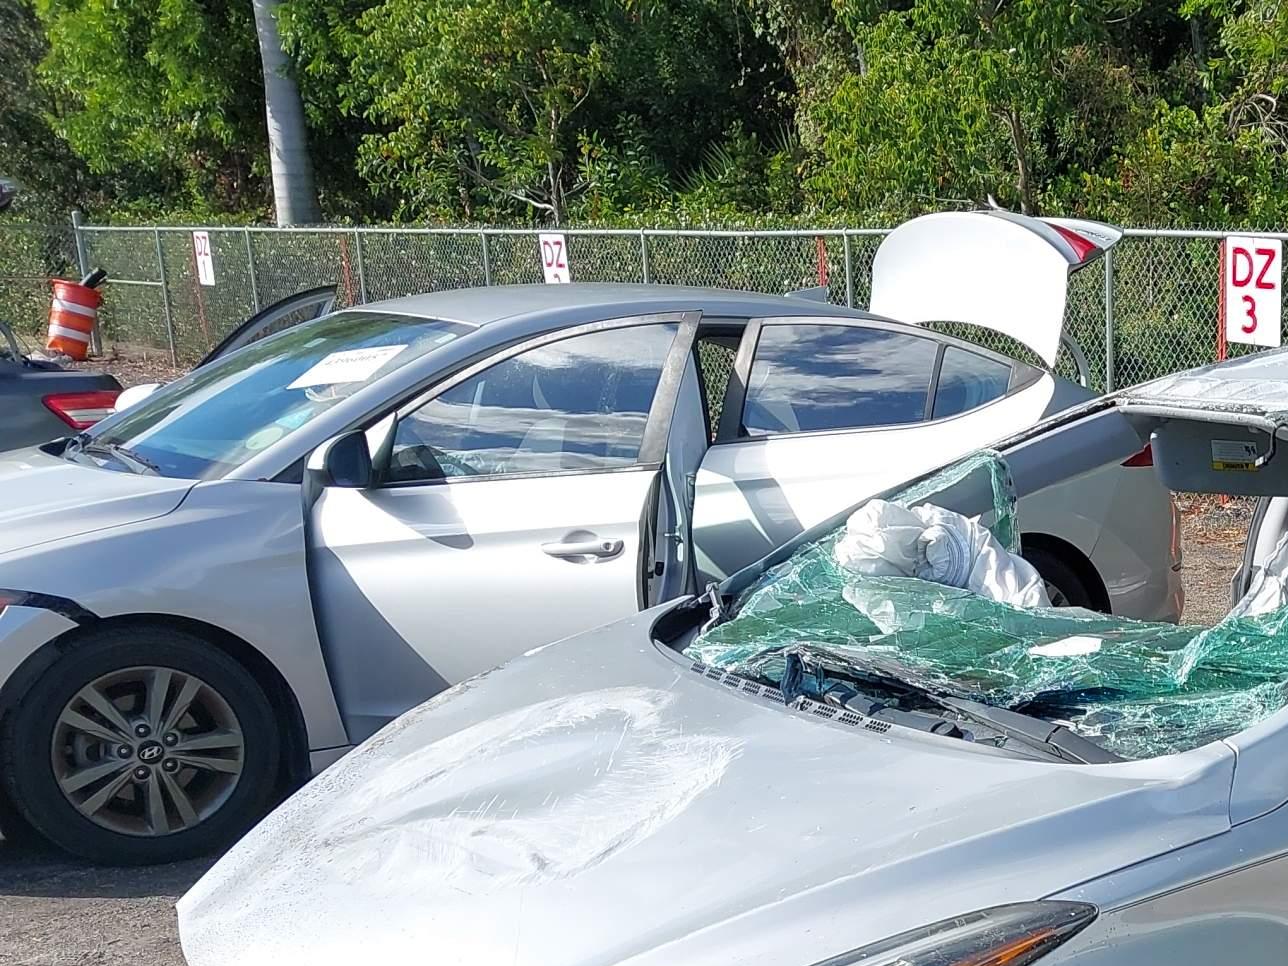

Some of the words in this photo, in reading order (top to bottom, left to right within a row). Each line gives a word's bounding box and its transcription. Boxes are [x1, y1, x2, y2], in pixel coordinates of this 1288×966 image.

[195, 235, 209, 256] DZ
[543, 240, 565, 268] DZ
[1232, 247, 1275, 289] DZ
[1241, 295, 1257, 334] 3
